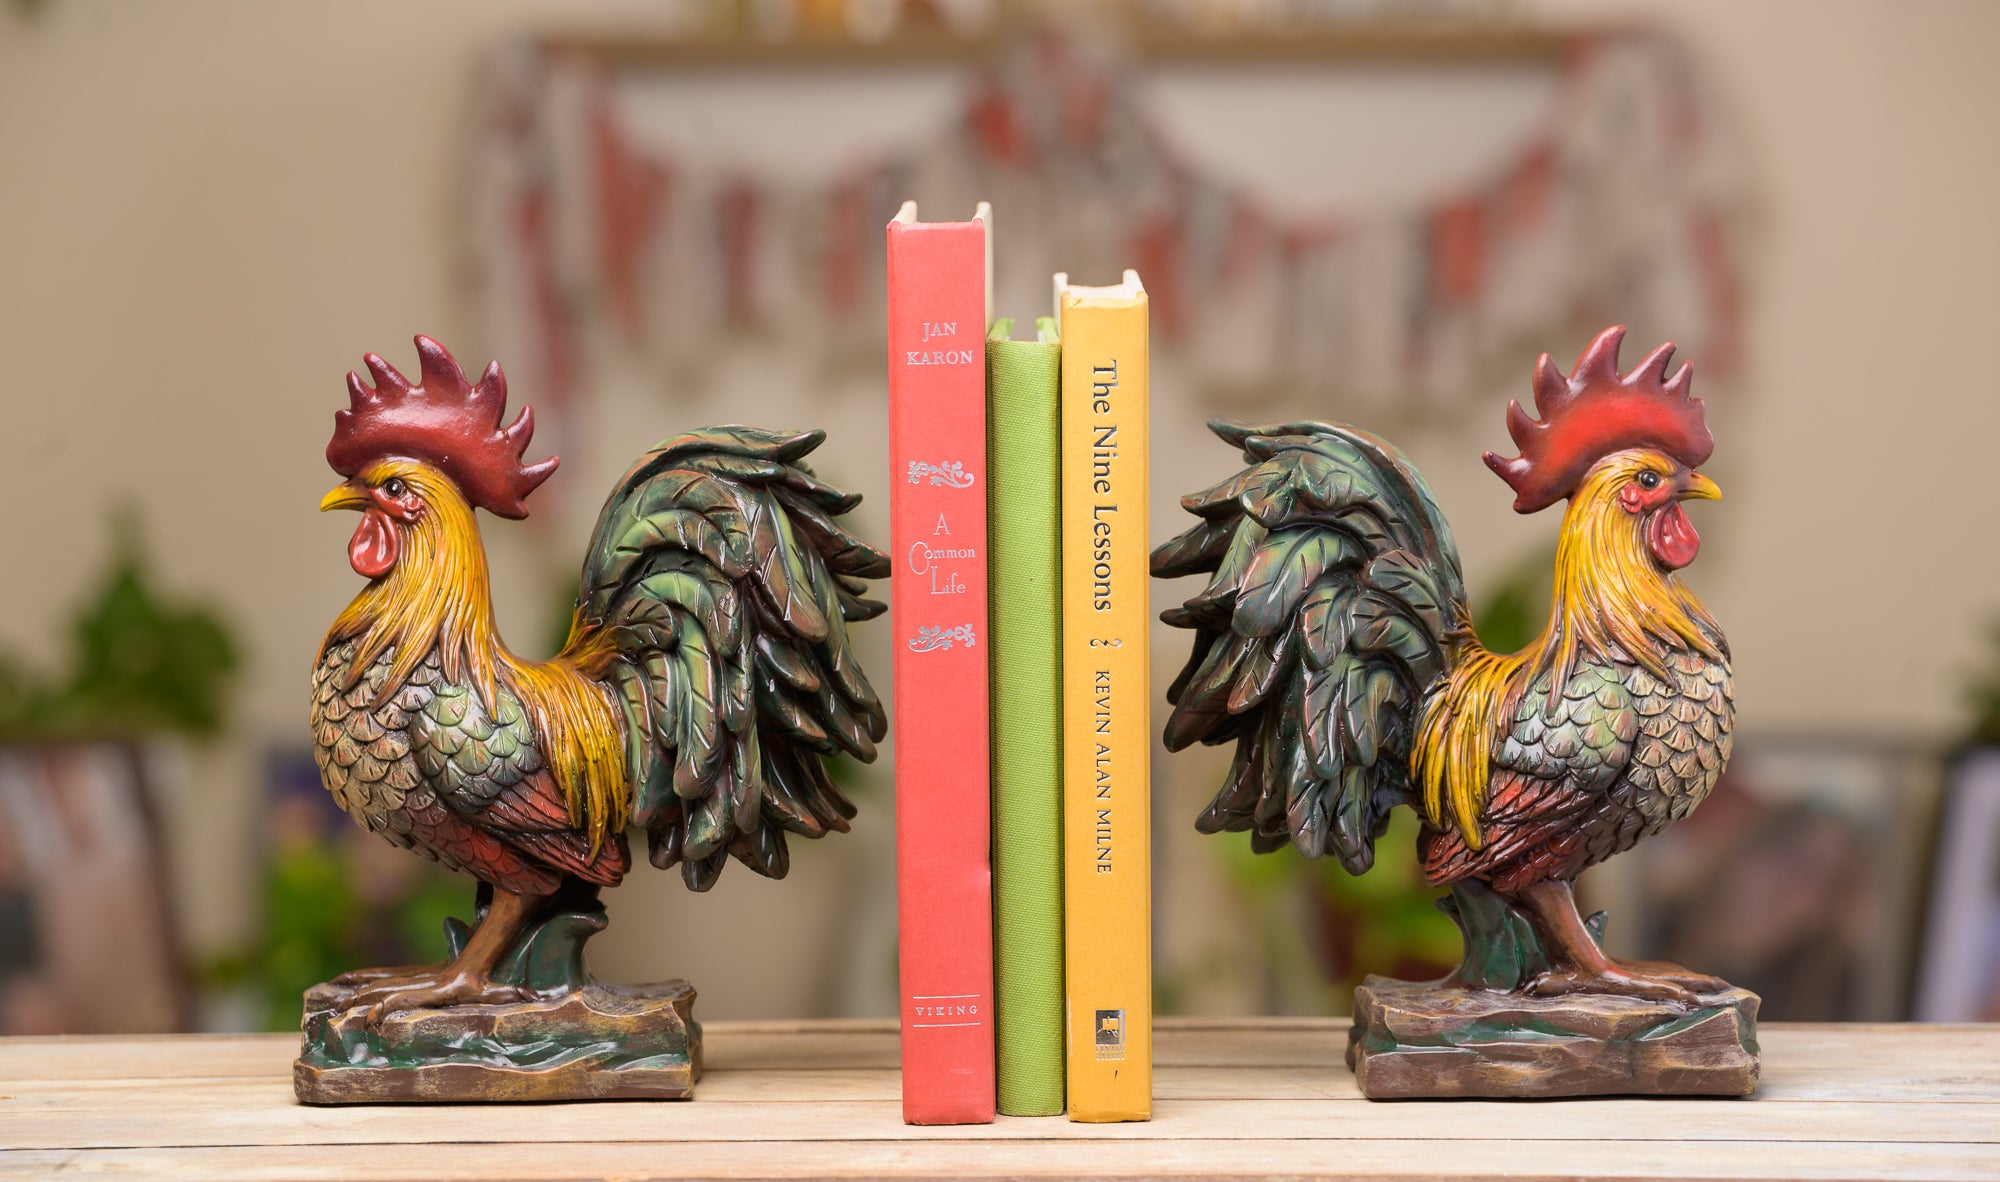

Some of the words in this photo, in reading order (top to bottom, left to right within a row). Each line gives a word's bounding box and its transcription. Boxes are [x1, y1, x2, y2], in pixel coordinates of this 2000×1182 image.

[923, 322, 957, 342] JAN
[906, 350, 973, 366] KARON
[1092, 359, 1118, 415] The
[1092, 424, 1119, 494] Nine
[933, 512, 951, 536] A
[908, 541, 976, 576] Common
[930, 566, 967, 595] Life
[1093, 504, 1119, 613] Lessons
[1095, 669, 1113, 733] KEVIN
[1095, 741, 1113, 800] ALAN
[1095, 808, 1114, 875] MILNE
[915, 1005, 978, 1016] VIKING
